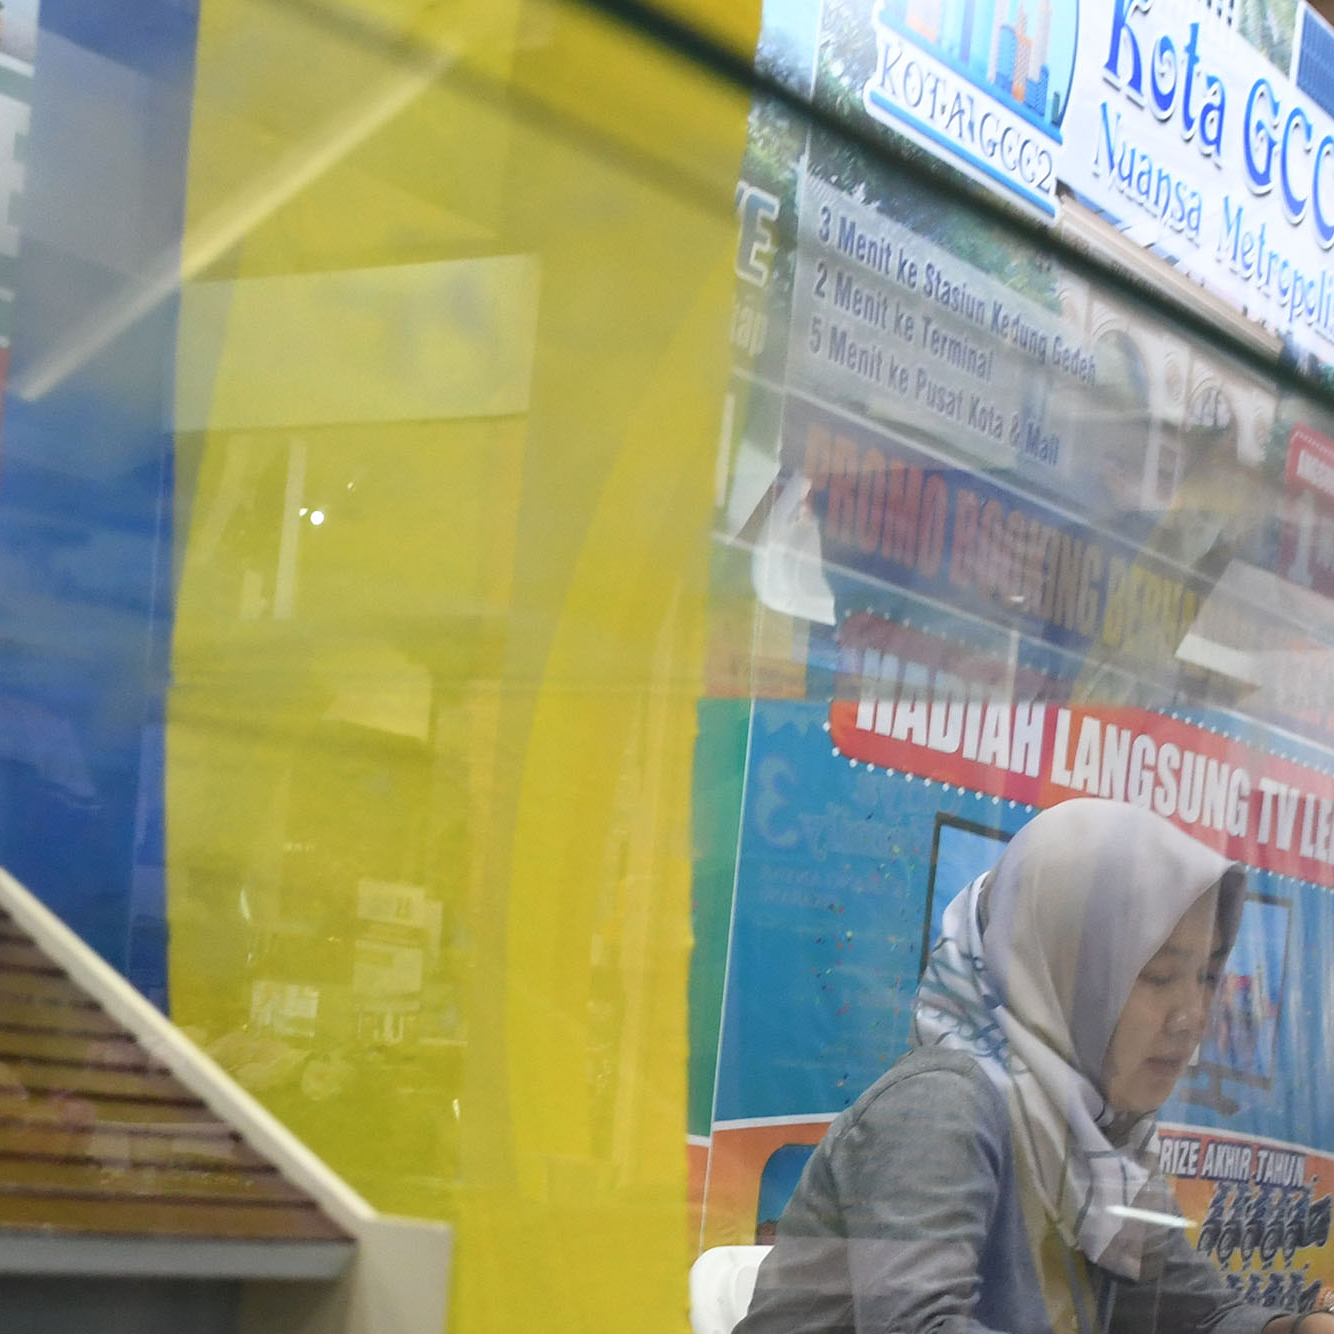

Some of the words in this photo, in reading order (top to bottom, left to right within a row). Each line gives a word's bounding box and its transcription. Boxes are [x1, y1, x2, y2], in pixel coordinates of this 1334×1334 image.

[1103, 0, 1228, 165] Kota
[1093, 100, 1204, 240] Nuansa
[814, 262, 829, 300] 2
[833, 271, 888, 330] Menit
[893, 306, 914, 344] ke
[921, 316, 994, 382] Terminal
[818, 205, 831, 244] 3
[837, 215, 893, 276] Menit
[897, 251, 917, 290] ke
[924, 262, 987, 327] Stasiun
[809, 315, 822, 355] 5
[827, 325, 885, 383] Menit
[888, 355, 910, 396] ke
[915, 366, 965, 421] Pusat
[967, 396, 1004, 443] Kota
[1022, 422, 1061, 467] Mall
[855, 648, 1048, 779] HADIAH
[1049, 707, 1250, 838] LANGSUNG
[1256, 777, 1302, 853] TV
[1157, 1137, 1201, 1177] RIZE
[1201, 1143, 1254, 1182] AKHIR
[1255, 1149, 1307, 1189] TAHUN
